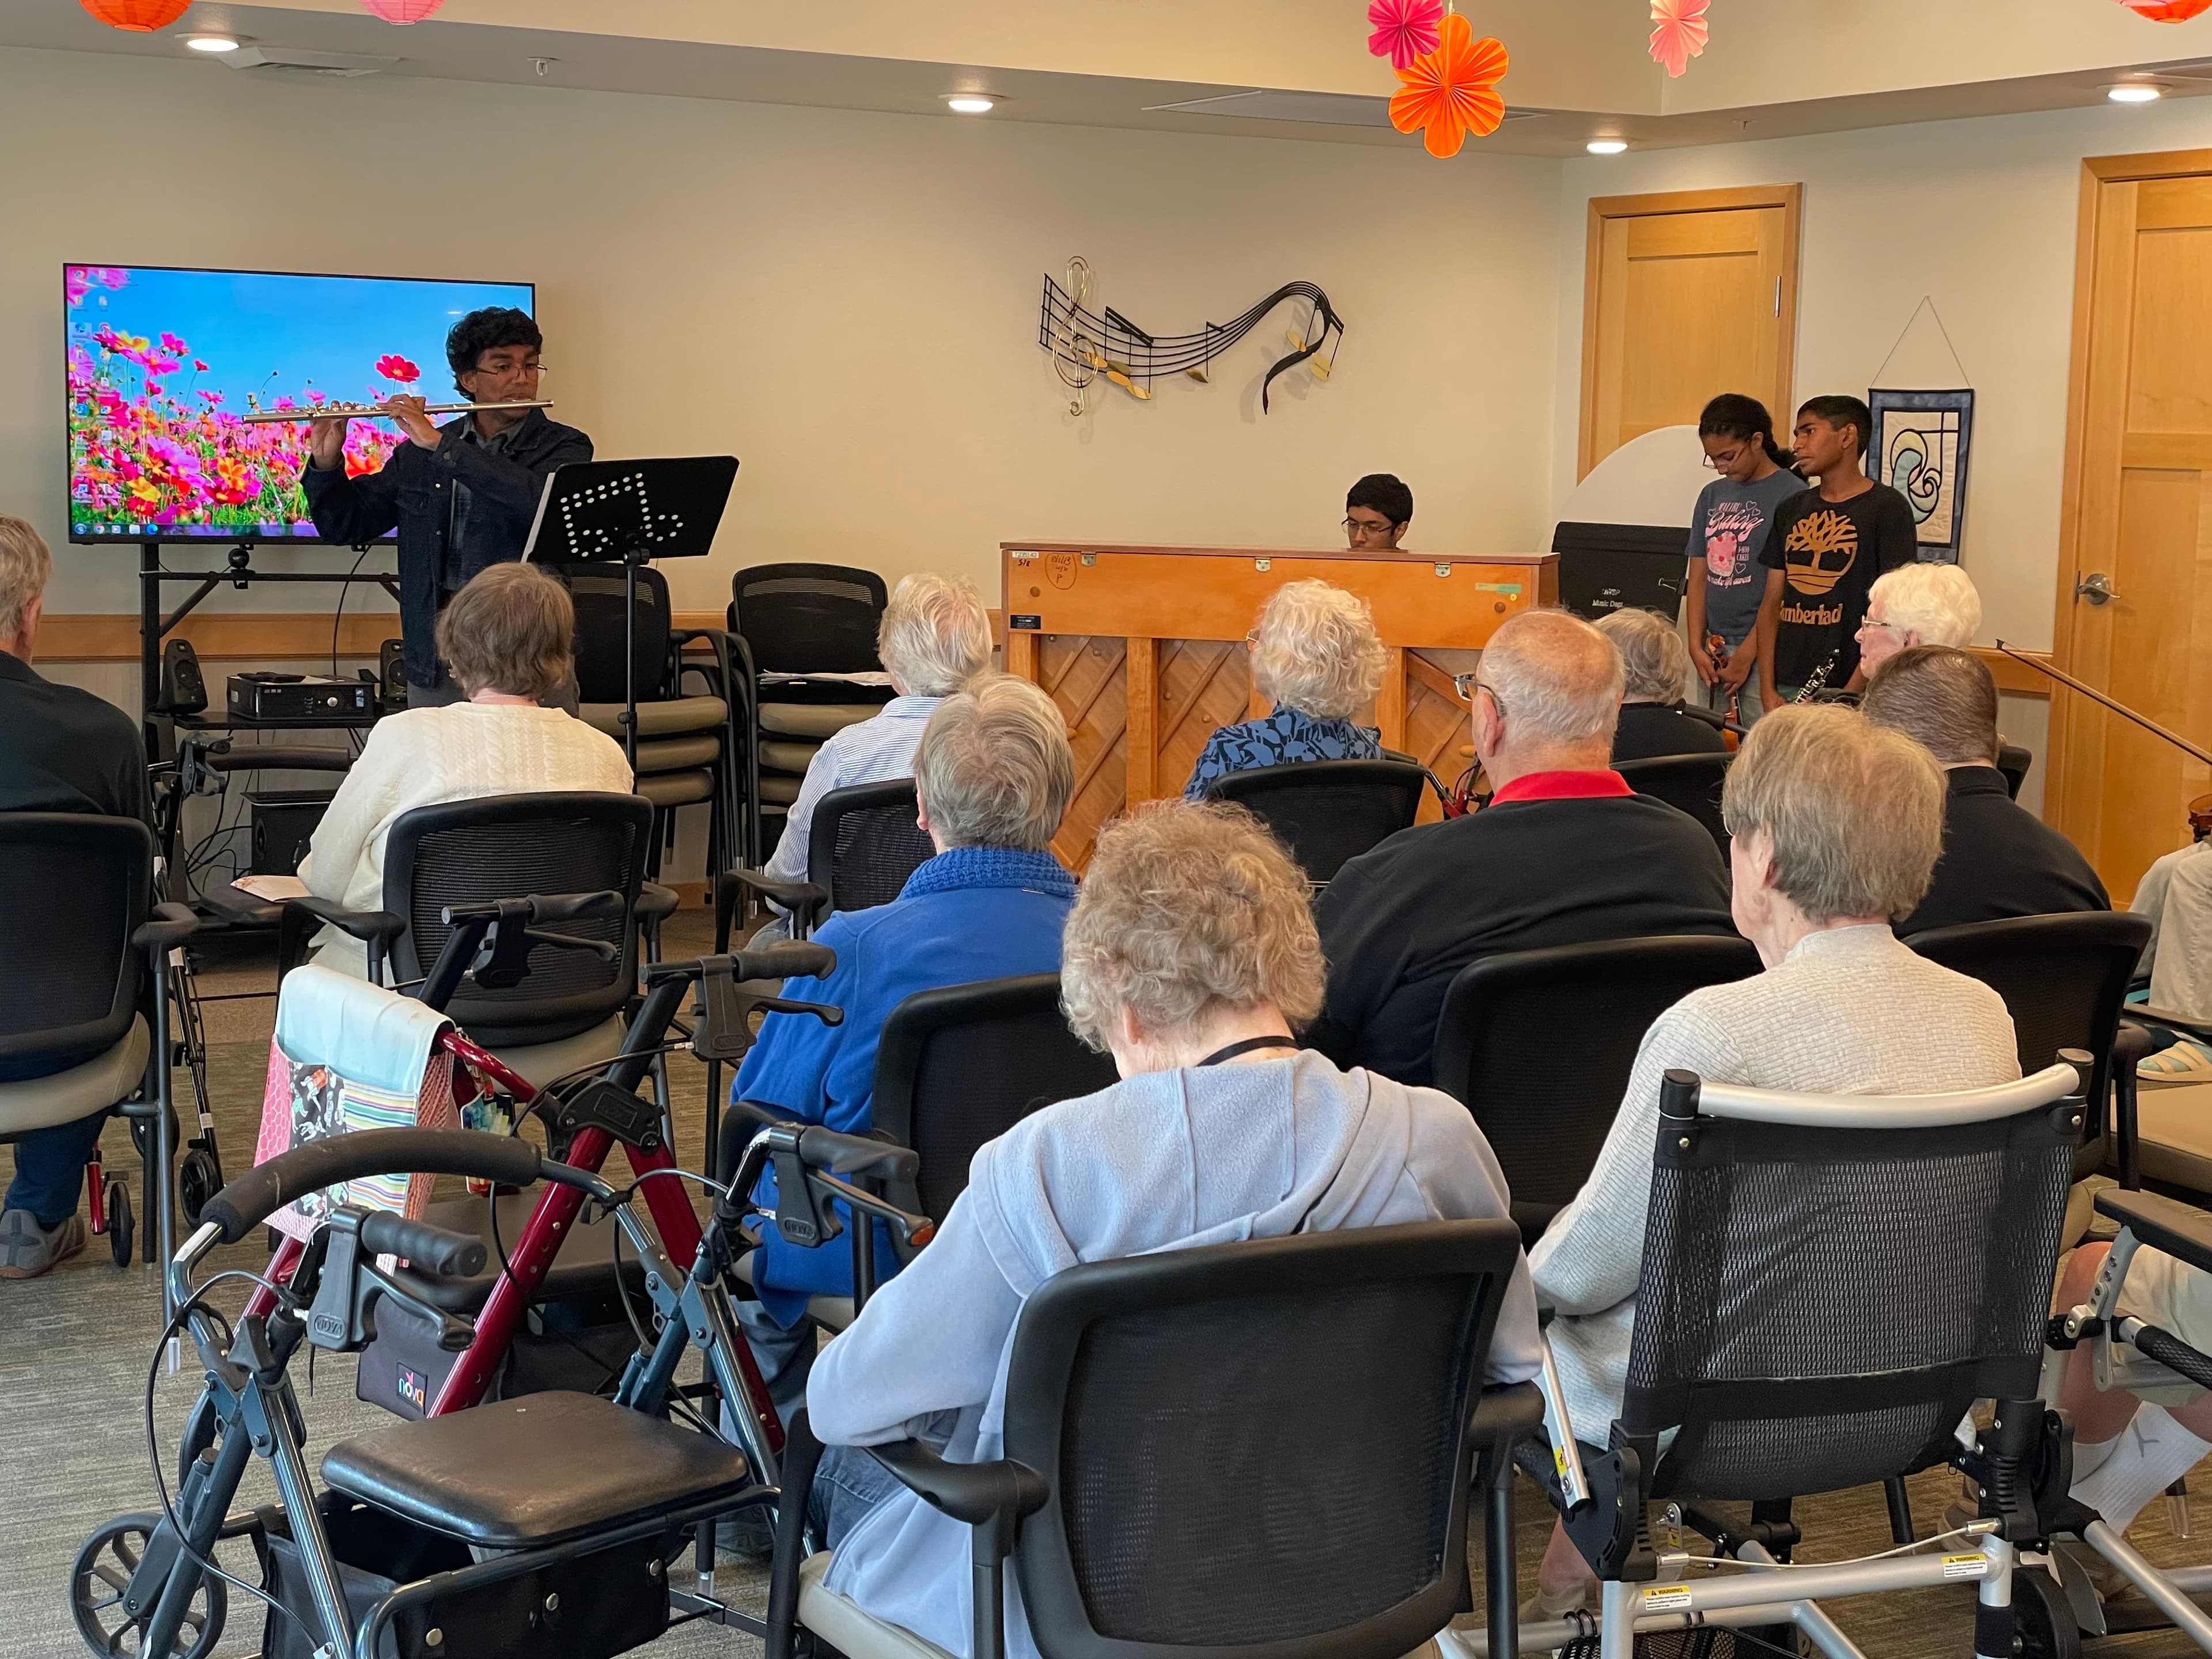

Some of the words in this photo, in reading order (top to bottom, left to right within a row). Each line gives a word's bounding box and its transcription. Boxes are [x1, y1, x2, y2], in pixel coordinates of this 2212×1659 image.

[1705, 509, 1764, 542] Bakery
[317, 1318, 342, 1335] NOVA
[399, 1378, 424, 1407] nova
